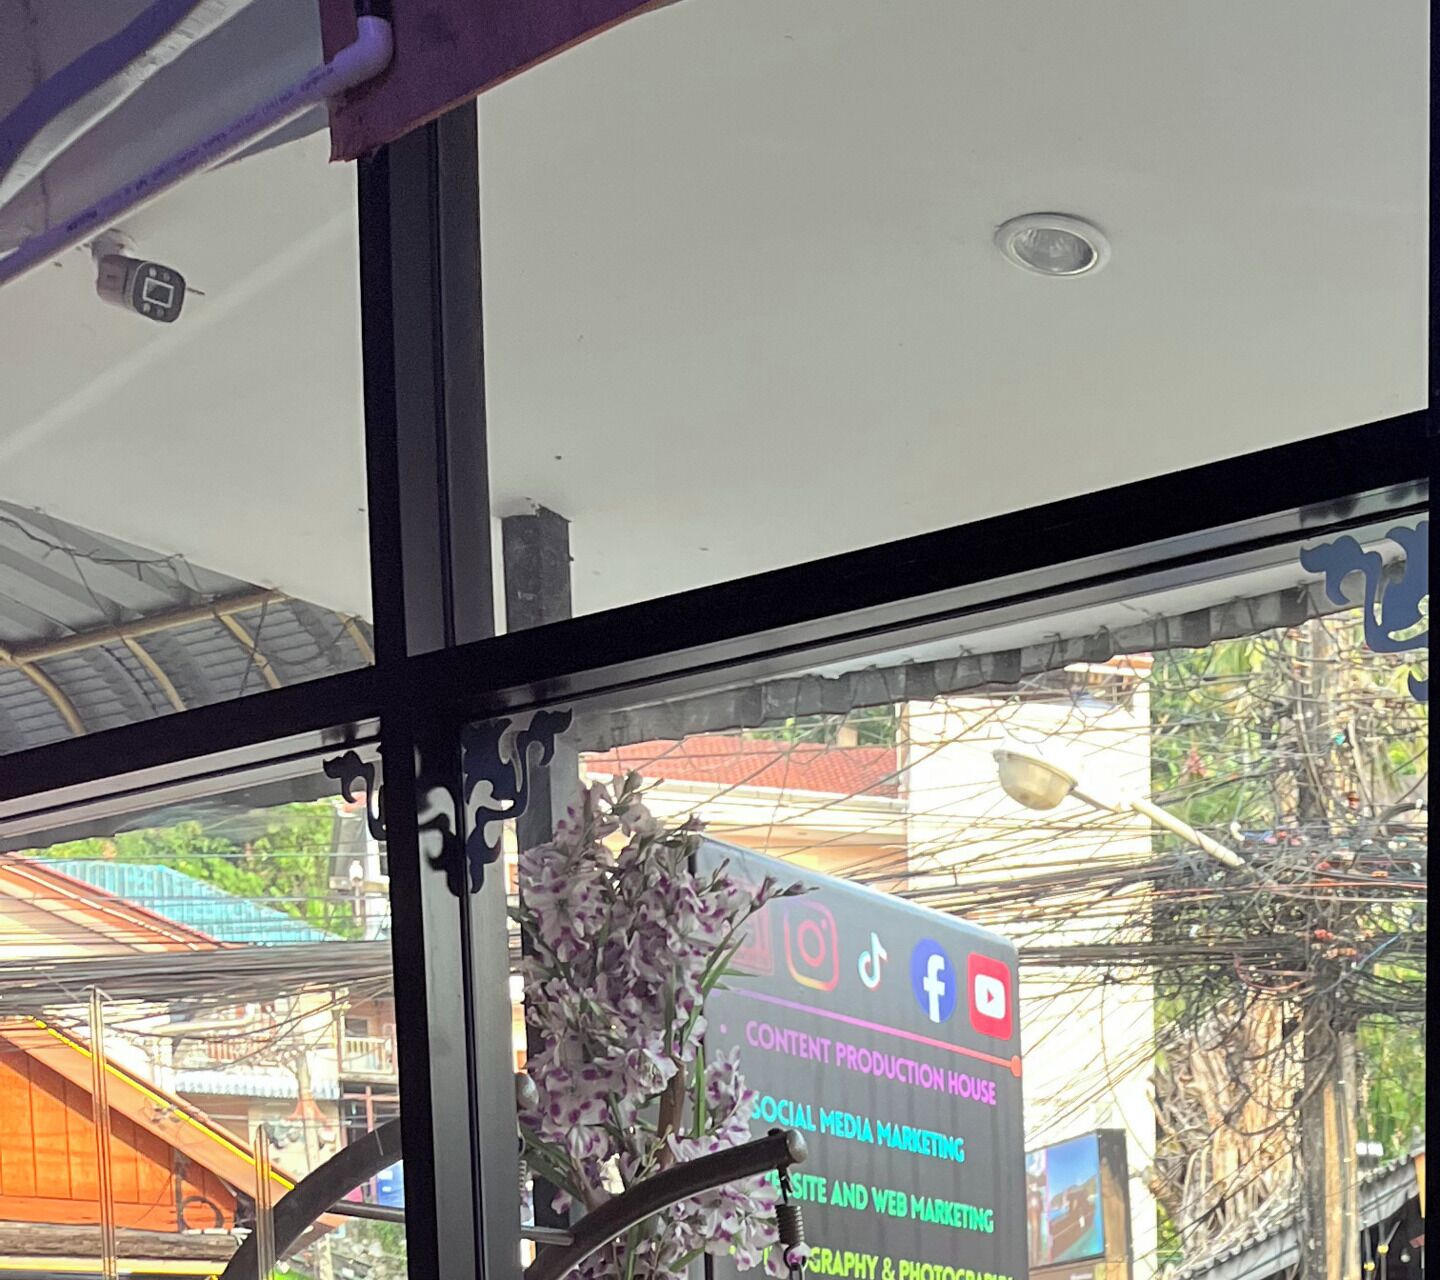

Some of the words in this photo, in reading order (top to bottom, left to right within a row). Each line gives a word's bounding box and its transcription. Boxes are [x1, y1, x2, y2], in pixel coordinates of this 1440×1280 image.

[745, 1020, 832, 1064] CONTENT
[835, 1041, 945, 1092] PRODUCTION
[947, 1070, 997, 1106] HOUSE
[751, 1091, 817, 1132] SOCIAL
[820, 1106, 874, 1143] MEDIA
[877, 1119, 966, 1163] MARKETING
[830, 1180, 869, 1210] AND
[871, 1186, 908, 1218] WEB
[911, 1194, 994, 1233] MARKETING
